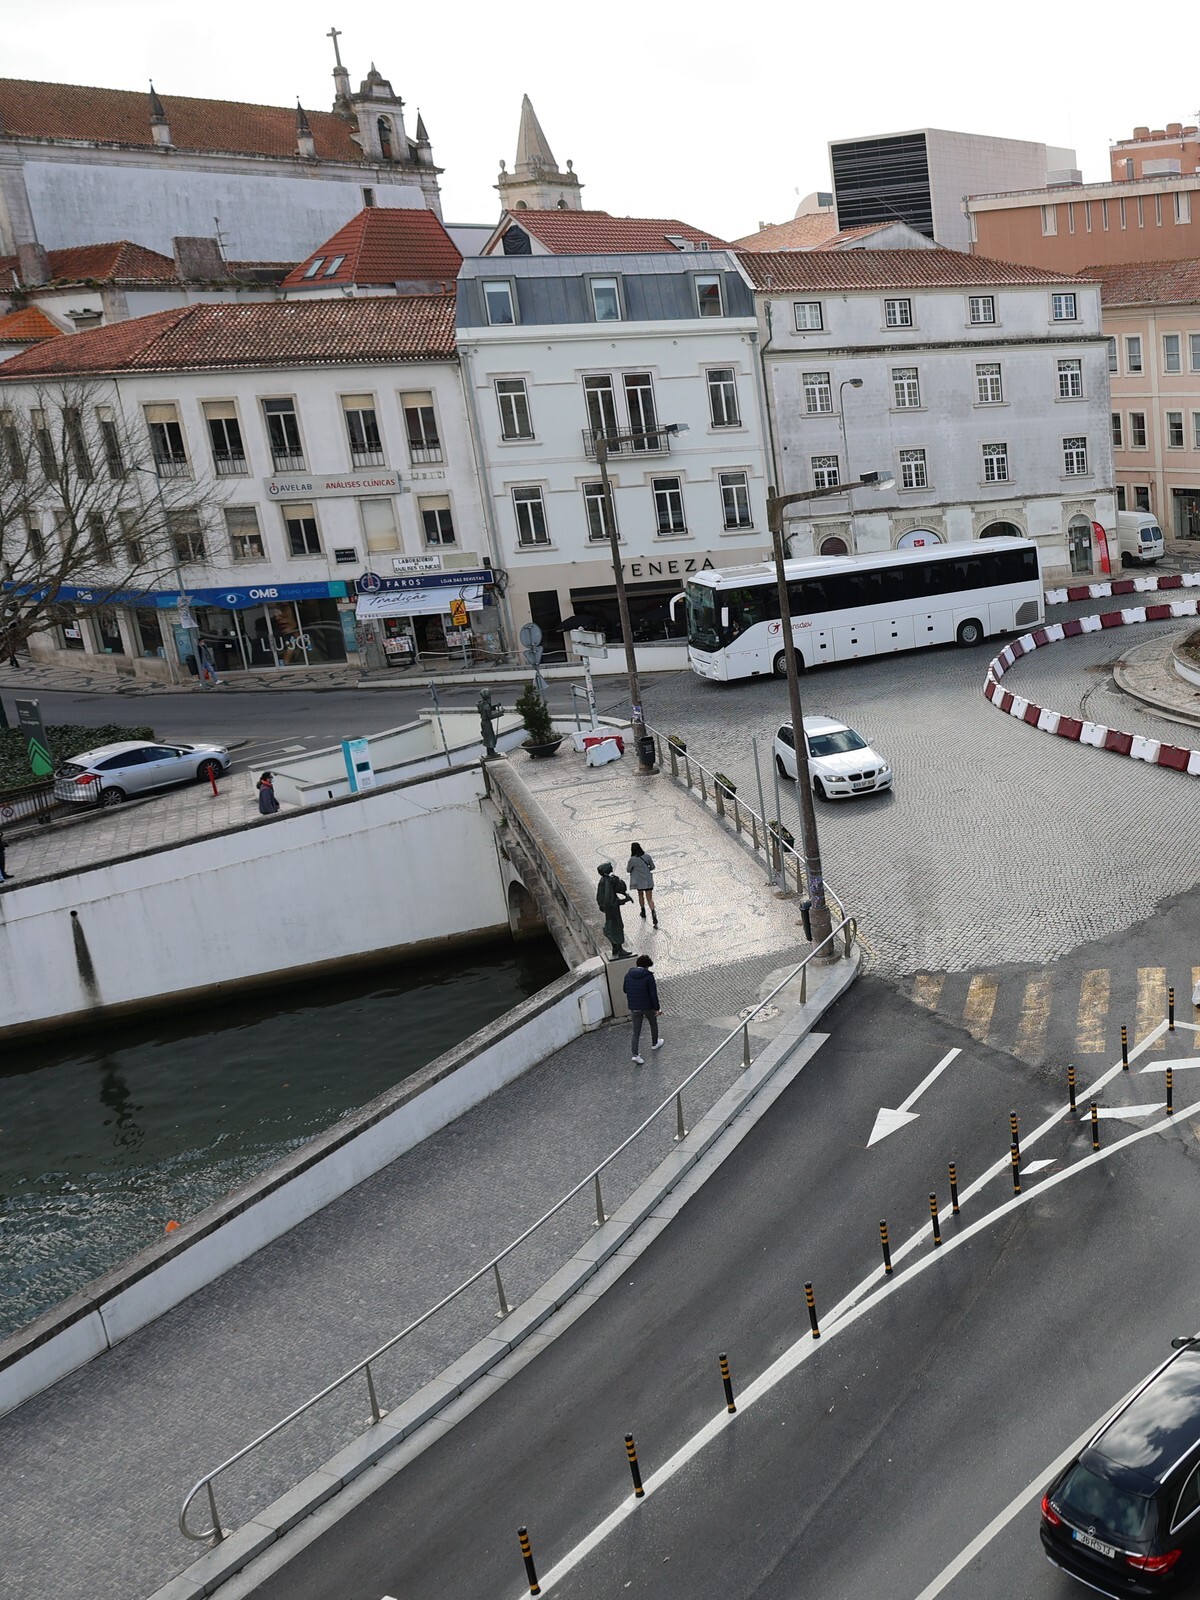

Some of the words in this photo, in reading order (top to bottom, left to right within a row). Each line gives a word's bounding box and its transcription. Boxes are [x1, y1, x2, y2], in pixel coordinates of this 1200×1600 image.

[280, 483, 313, 492] AVELAB
[325, 481, 361, 489] ANÁLISES
[362, 478, 396, 487] CLÍNICAS
[248, 588, 279, 599] OMB
